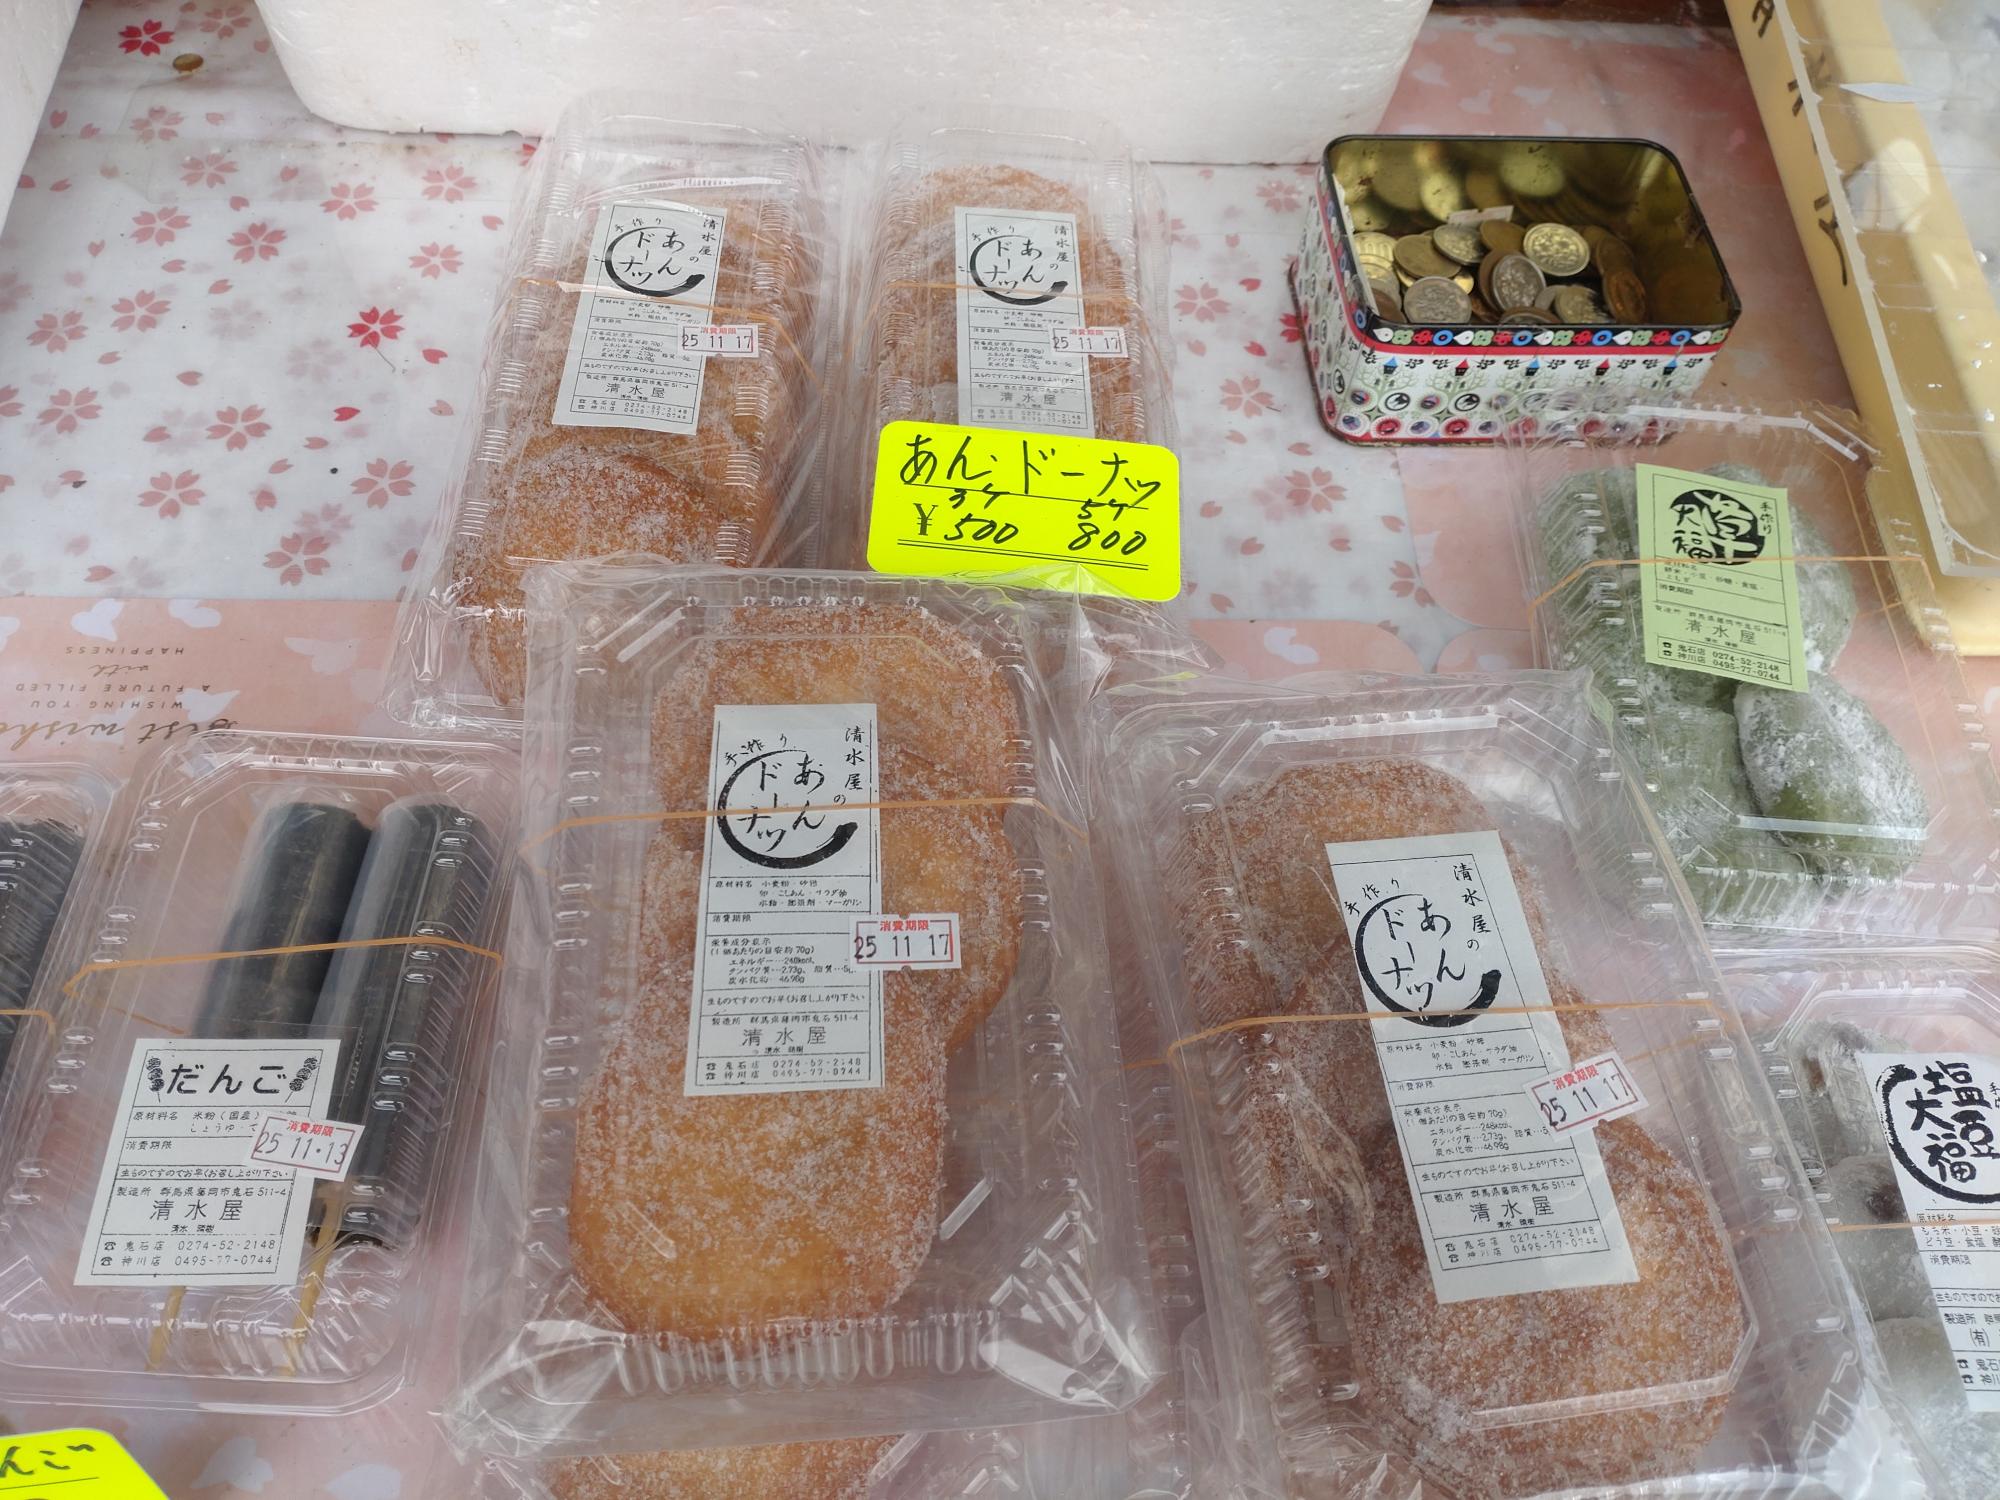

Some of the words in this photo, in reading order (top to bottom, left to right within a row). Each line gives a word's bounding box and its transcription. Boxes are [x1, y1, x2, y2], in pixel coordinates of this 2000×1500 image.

[689, 217, 719, 263] 清水屋の
[1050, 225, 1070, 271] 清水屋の
[657, 230, 686, 276] あん
[1021, 238, 1043, 284] あん
[681, 334, 699, 348] 25
[709, 335, 724, 349] 11
[736, 335, 753, 350] 17
[1052, 336, 1069, 350] 25
[1078, 336, 1093, 351] 11
[1104, 337, 1121, 351] 17
[1068, 522, 1147, 555] 800
[67, 646, 184, 655] HAPPINESS
[89, 664, 149, 677] with
[16, 684, 87, 692] FILLED
[104, 684, 183, 692] FUTURE
[202, 684, 211, 692] A
[30, 700, 71, 709] YOU
[89, 700, 183, 709] WISHING
[834, 727, 865, 807] 清水屋の
[793, 753, 825, 831] あん
[712, 914, 751, 923] 消費期限
[1453, 863, 1491, 952] 清水屋の
[879, 920, 930, 932] 消費期限
[854, 935, 877, 959] 25
[892, 934, 912, 957] 11
[928, 933, 952, 957] 17
[1416, 897, 1466, 984] あん
[742, 1026, 828, 1048] 清水屋
[166, 1063, 287, 1095] だんご
[1552, 1064, 1600, 1090] 消費期限
[1540, 1097, 1567, 1127] 25
[1572, 1086, 1598, 1113] 11
[1602, 1074, 1631, 1101] 17
[132, 1111, 179, 1121] 原材料名
[286, 1120, 334, 1137] 消費期限
[1905, 1087, 1977, 1183] 大福
[125, 1140, 173, 1150] 消費期限
[255, 1132, 283, 1155] 25
[116, 1186, 151, 1197] 製造所
[149, 1199, 244, 1221] 清水屋
[1469, 1195, 1555, 1223] 清水屋
[177, 1239, 276, 1251] 0274-52-2148
